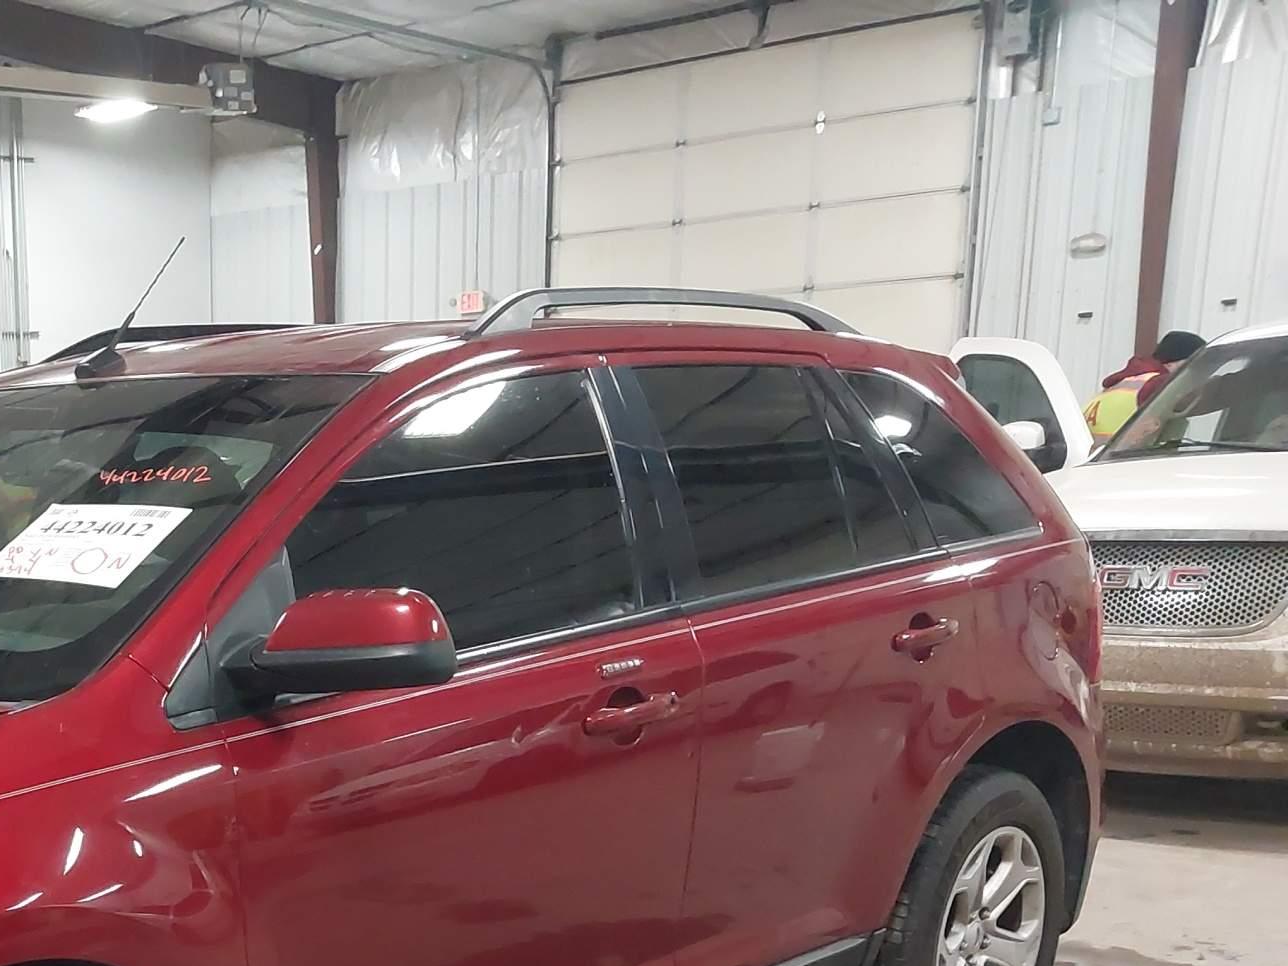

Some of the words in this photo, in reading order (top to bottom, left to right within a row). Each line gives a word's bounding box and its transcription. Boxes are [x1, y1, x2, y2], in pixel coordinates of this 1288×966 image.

[99, 465, 212, 486] 44224012
[40, 520, 154, 537] 44224012
[1100, 565, 1210, 592] GMC
